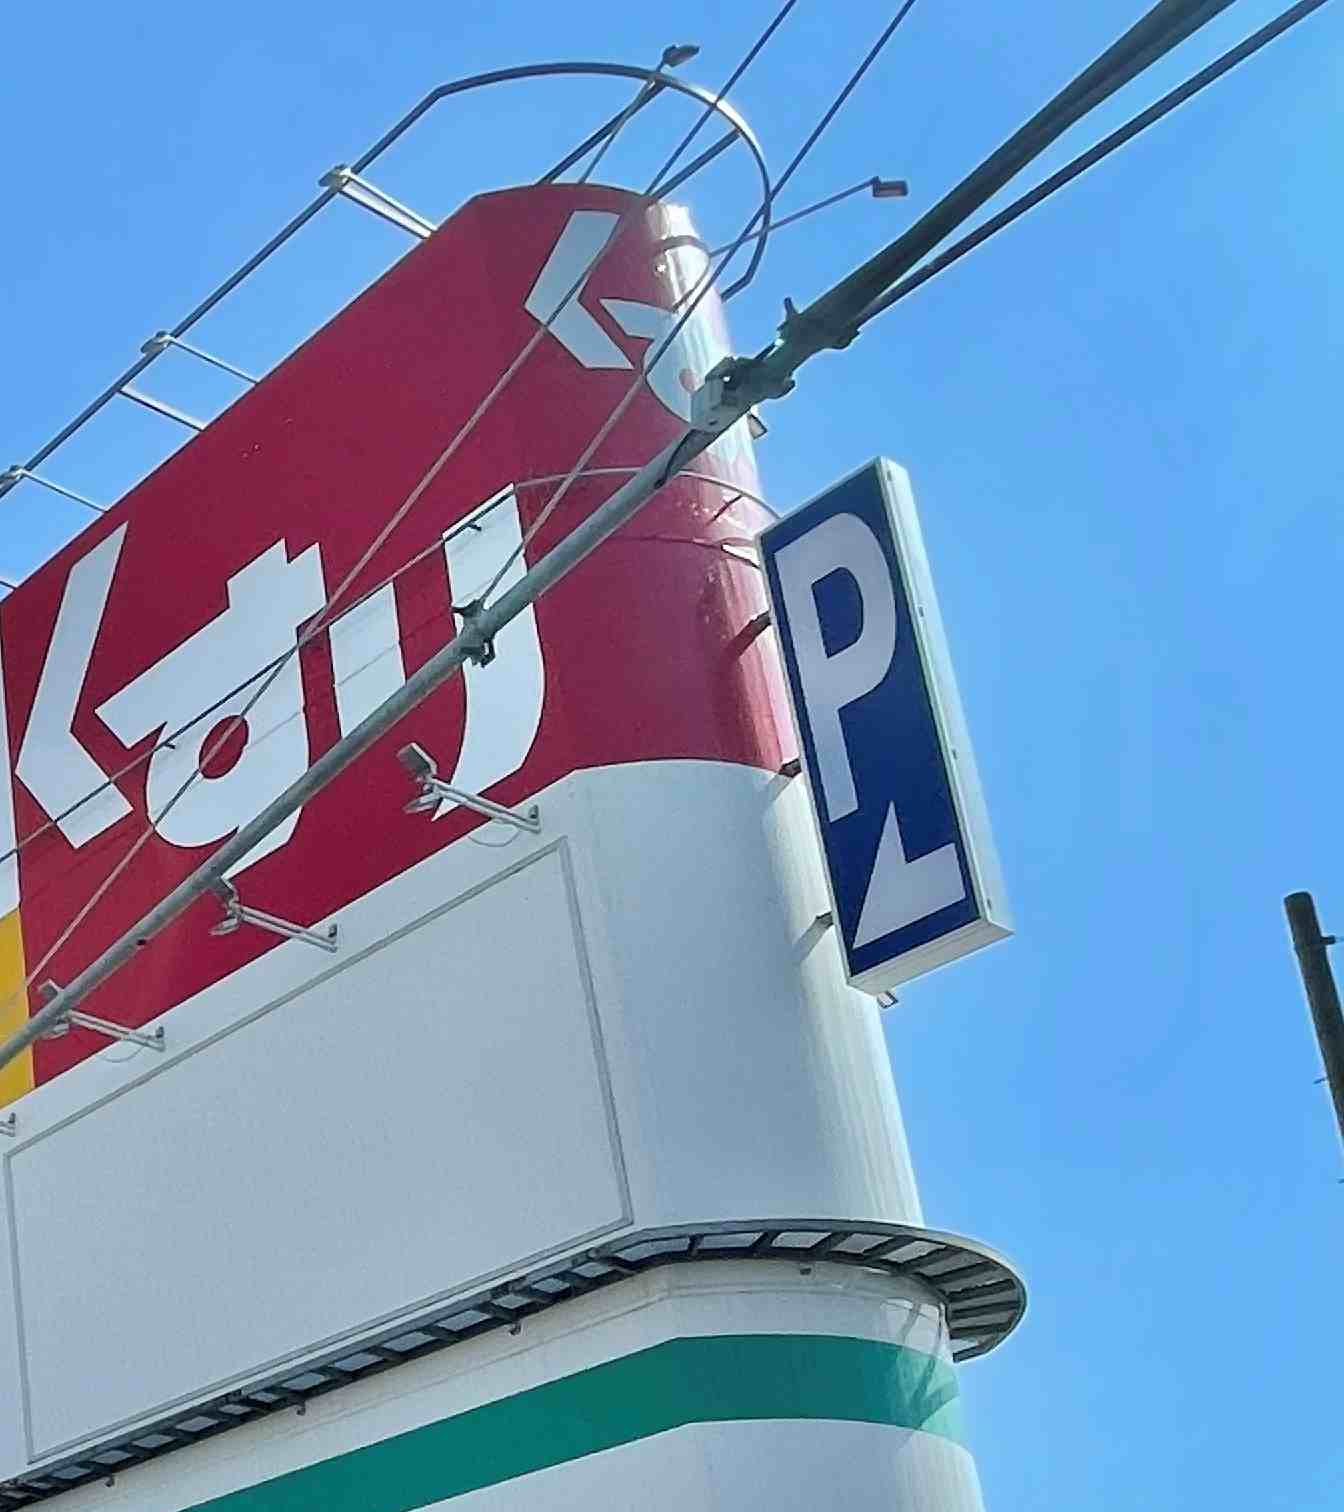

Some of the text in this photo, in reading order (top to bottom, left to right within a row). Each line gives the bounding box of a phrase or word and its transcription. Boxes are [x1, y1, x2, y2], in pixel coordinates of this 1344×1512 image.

[15, 484, 546, 878] くすり
[774, 512, 895, 823] P
